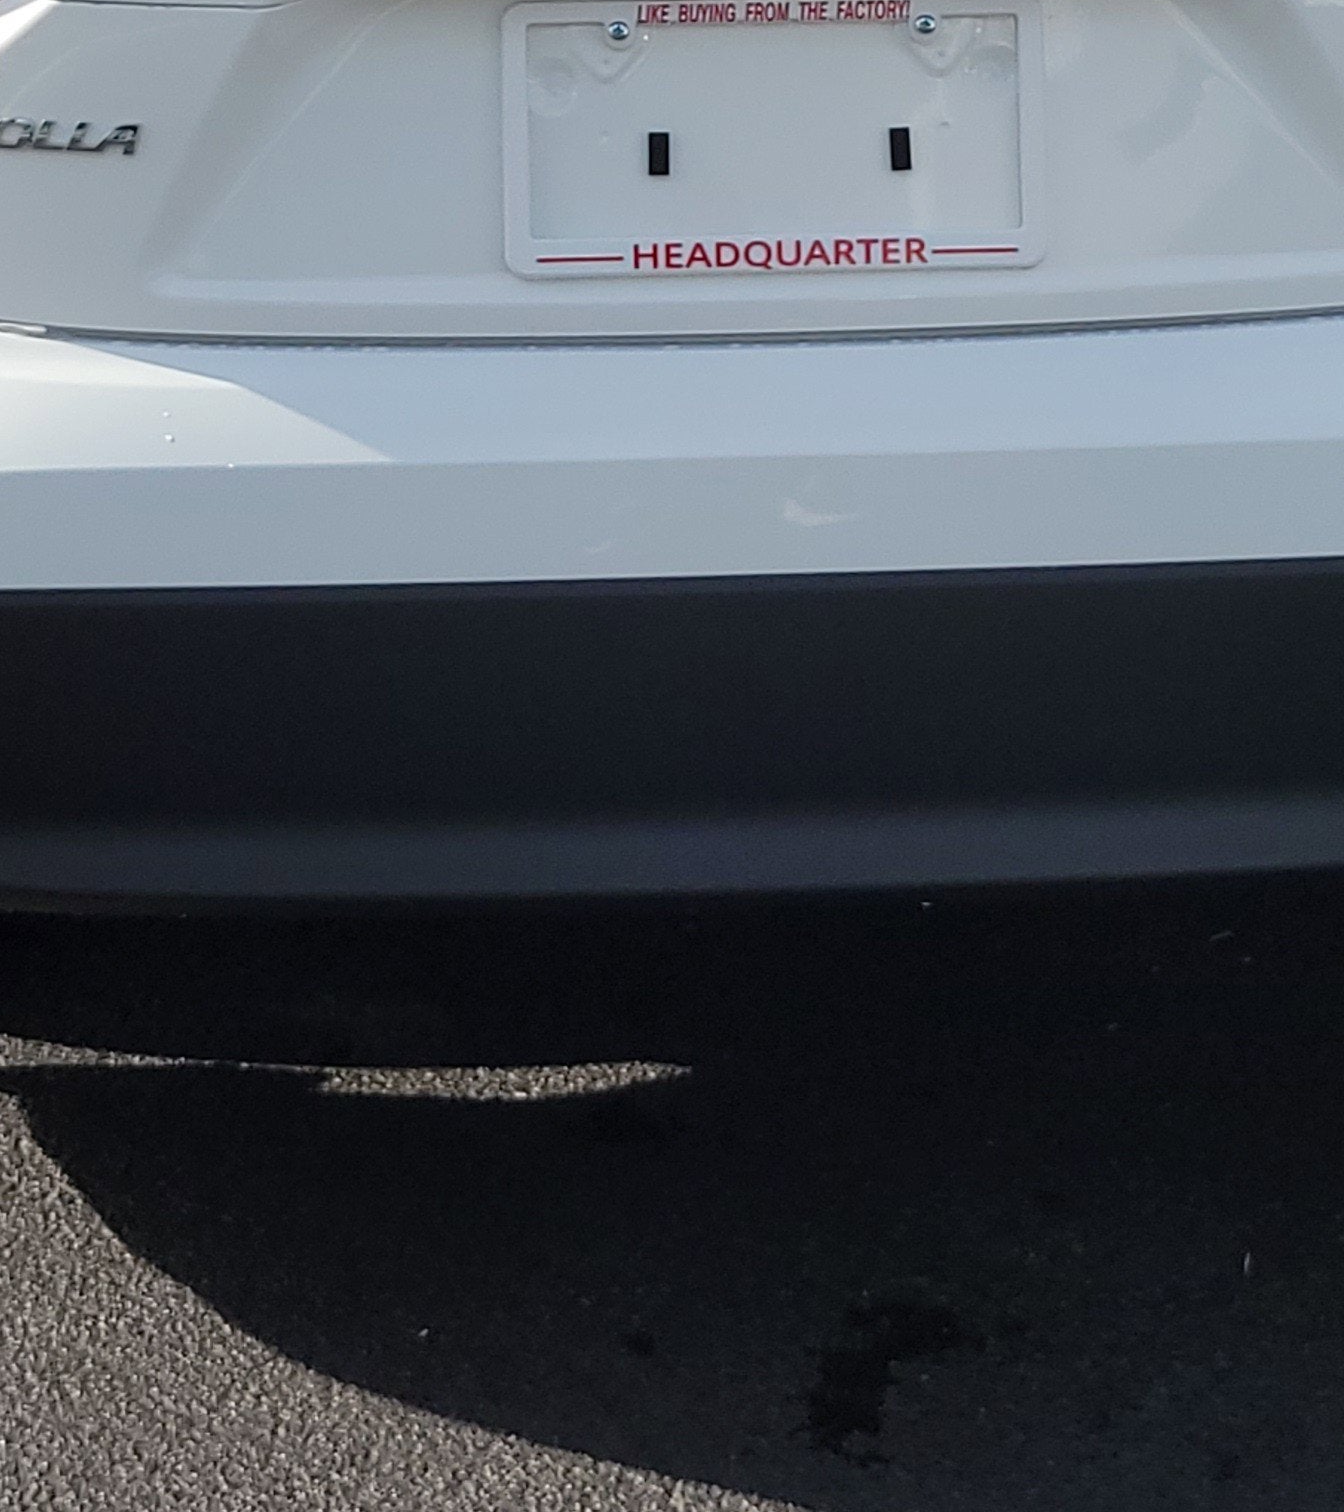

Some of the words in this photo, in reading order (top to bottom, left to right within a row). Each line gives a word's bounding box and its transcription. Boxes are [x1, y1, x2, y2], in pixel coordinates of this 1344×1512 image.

[637, 3, 670, 24] LIKE
[678, 2, 736, 23] BUYING
[745, 1, 790, 22] FROM
[798, 0, 829, 21] THE
[837, 0, 911, 21] FACTORY!
[632, 238, 928, 270] HEADQUARTER
